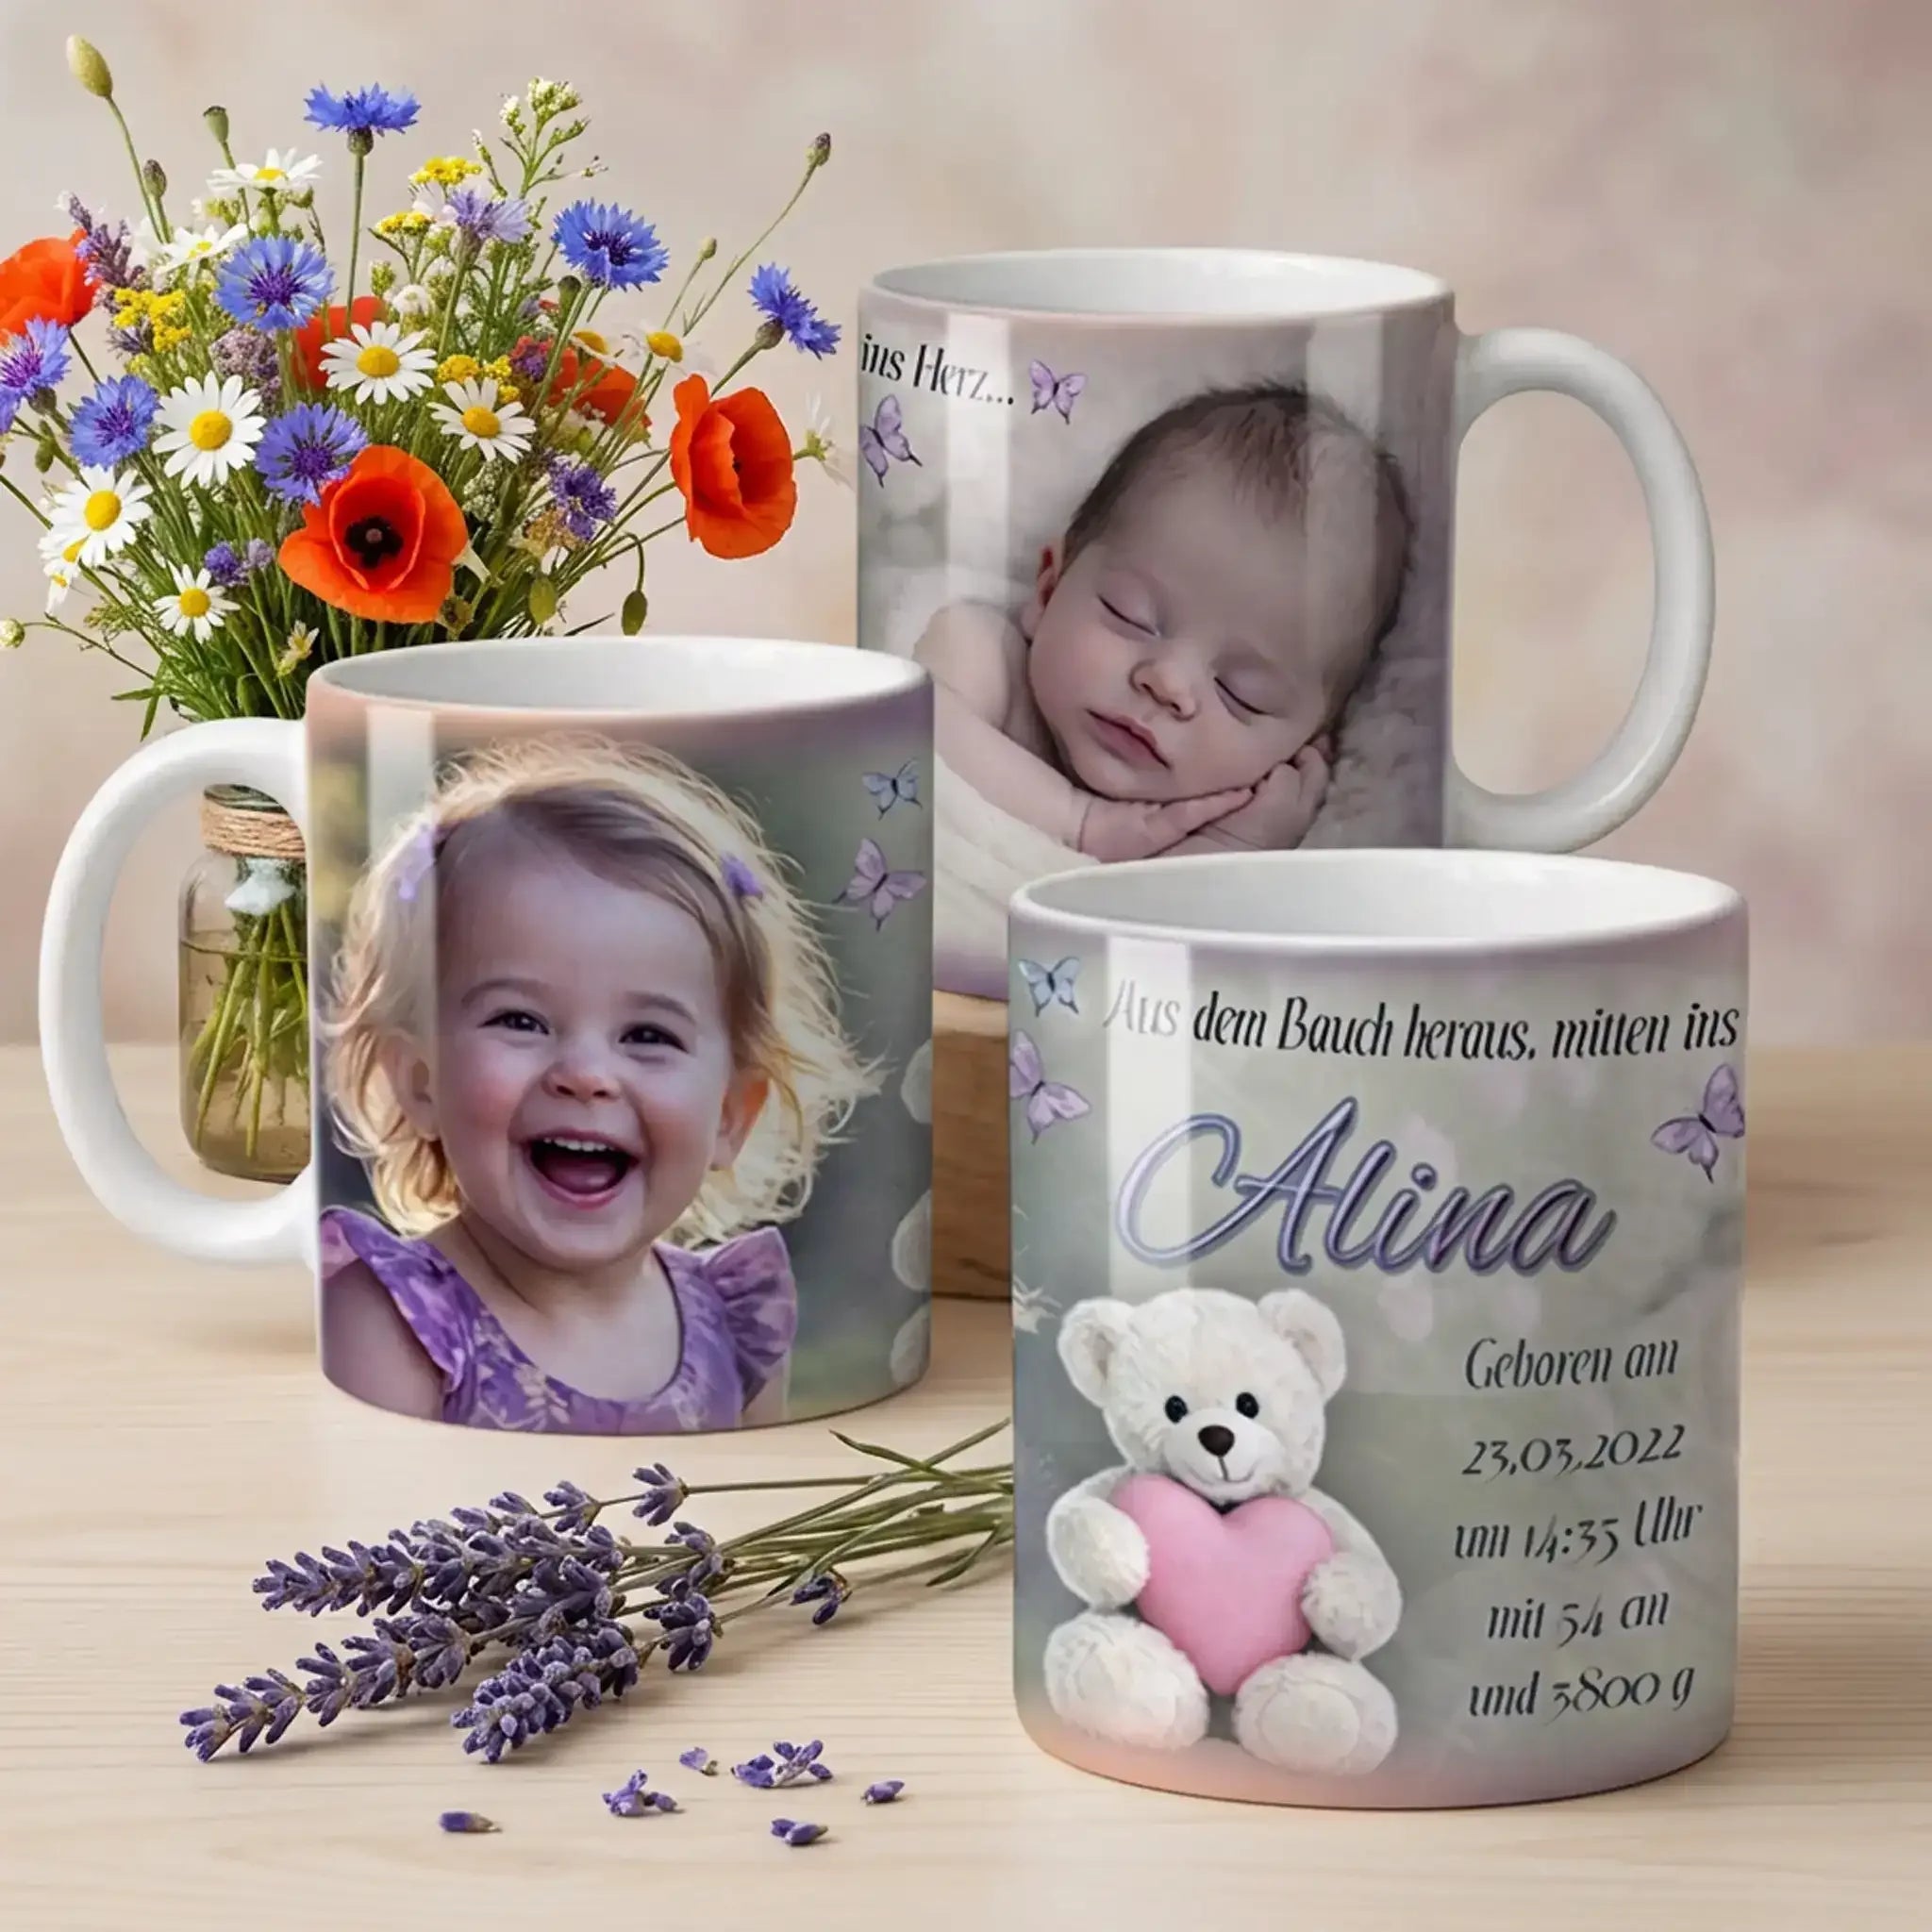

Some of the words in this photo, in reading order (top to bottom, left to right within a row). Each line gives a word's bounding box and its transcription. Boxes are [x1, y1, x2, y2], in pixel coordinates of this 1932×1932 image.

[858, 334, 905, 381] ins
[1102, 979, 1180, 1036] Aus
[1192, 990, 1268, 1048] dem
[1275, 995, 1394, 1057] Bauch
[1552, 1008, 1670, 1058] mitten
[1683, 1002, 1740, 1051] ins
[1114, 1095, 1617, 1276] Alina
[1465, 1337, 1612, 1390] Geboren
[1624, 1339, 1679, 1379] am
[1455, 1524, 1510, 1559] um
[1523, 1514, 1620, 1566] 14:35
[1634, 1495, 1704, 1547] Uhr
[1487, 1598, 1546, 1640] mit
[1557, 1594, 1604, 1649] 54
[1469, 1670, 1541, 1717] und
[1672, 1667, 1695, 1711] g
